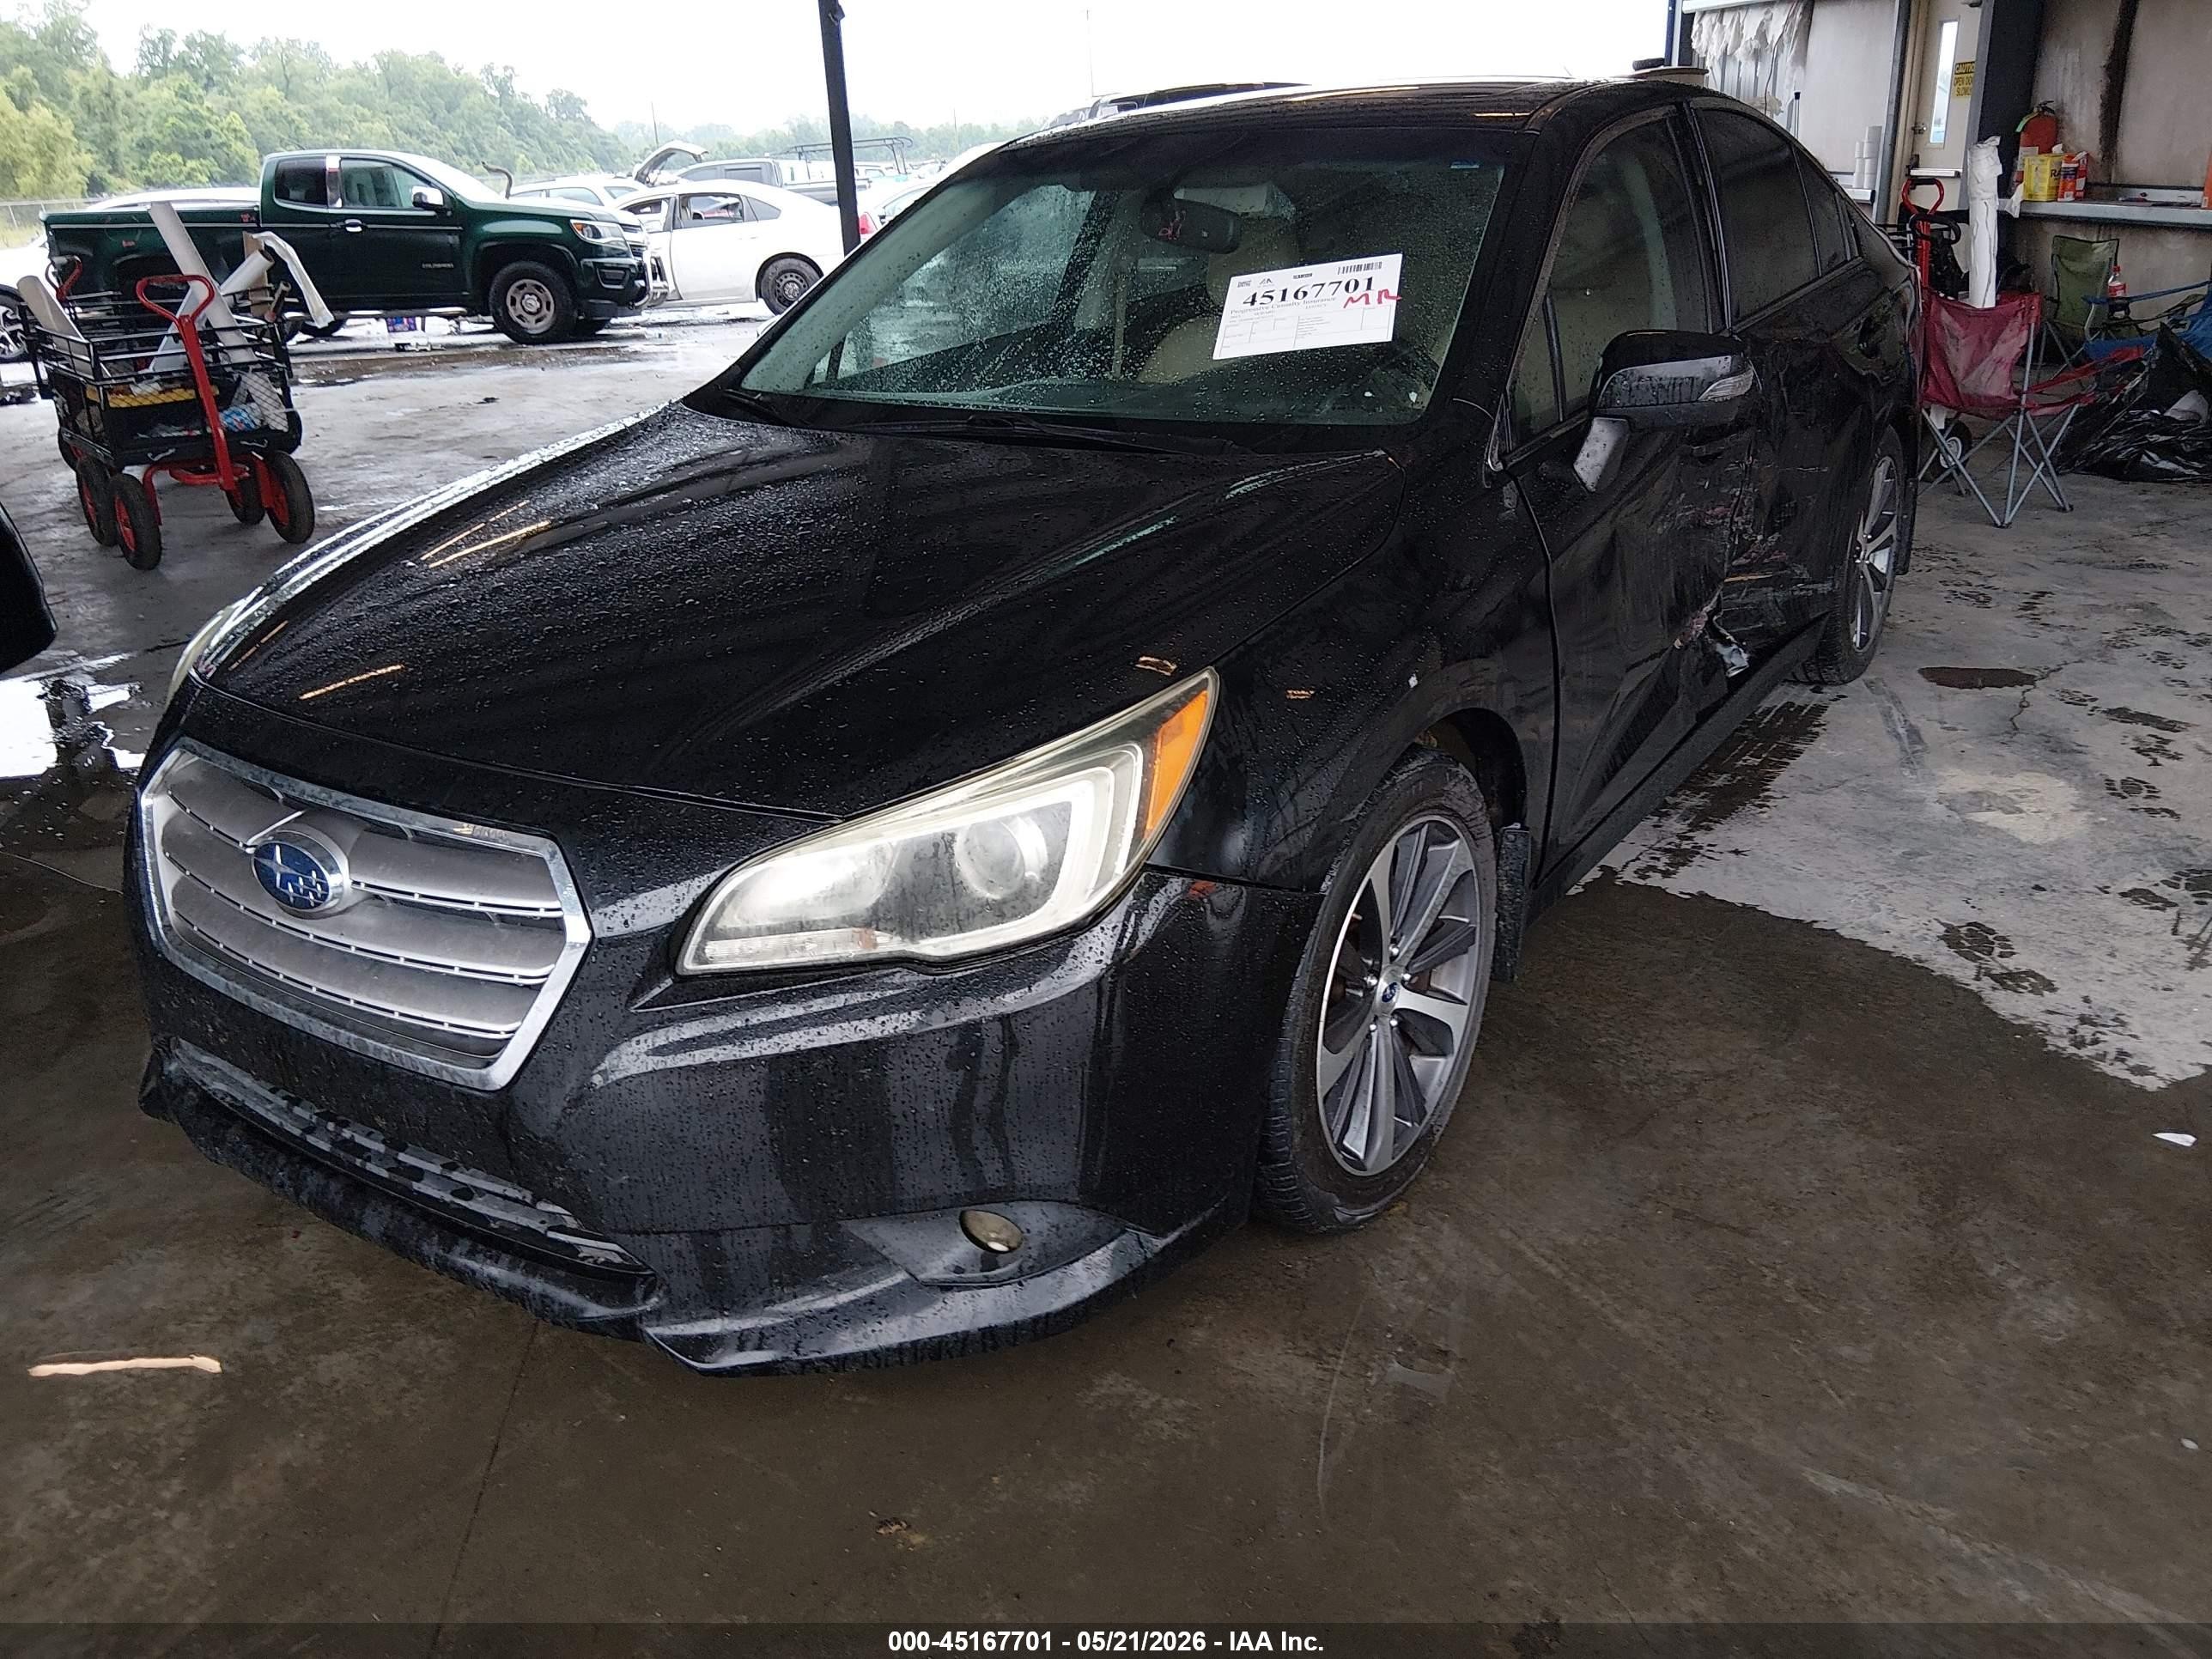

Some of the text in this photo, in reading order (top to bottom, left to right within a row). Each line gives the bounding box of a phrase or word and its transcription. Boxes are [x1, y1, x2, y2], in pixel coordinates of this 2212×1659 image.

[1955, 63, 1976, 74] CAUTIO
[2050, 169, 2062, 179] RA
[1243, 276, 1374, 307] 45167701
[1231, 305, 1271, 315] Progressive
[1272, 300, 1300, 309] Casualty
[1303, 296, 1336, 305] Insurance
